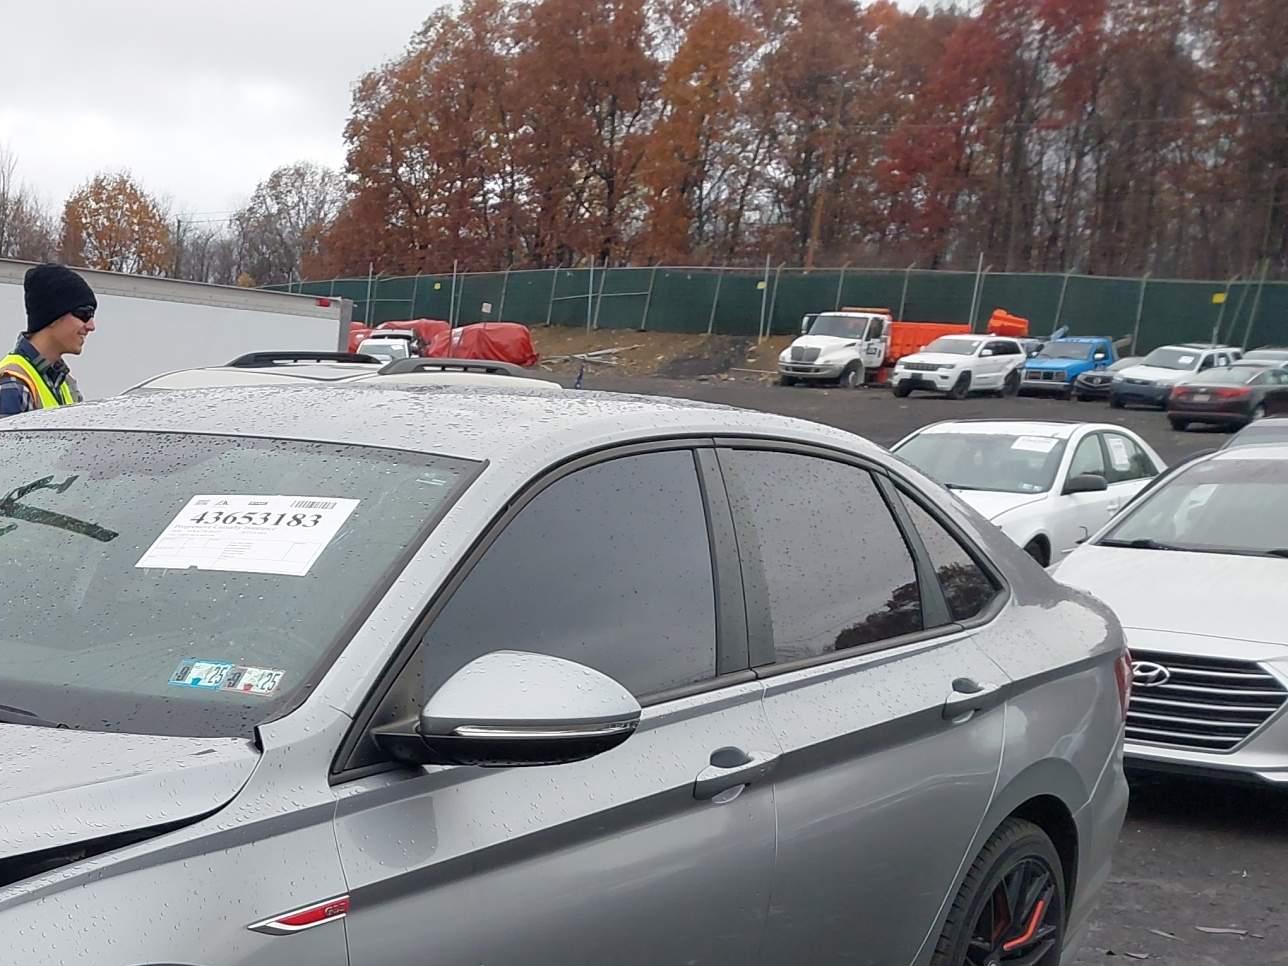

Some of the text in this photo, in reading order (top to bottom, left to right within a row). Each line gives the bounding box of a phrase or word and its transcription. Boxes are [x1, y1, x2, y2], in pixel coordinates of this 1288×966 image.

[190, 510, 323, 528] 43653183
[208, 666, 227, 684] 25
[260, 673, 280, 691] 25
